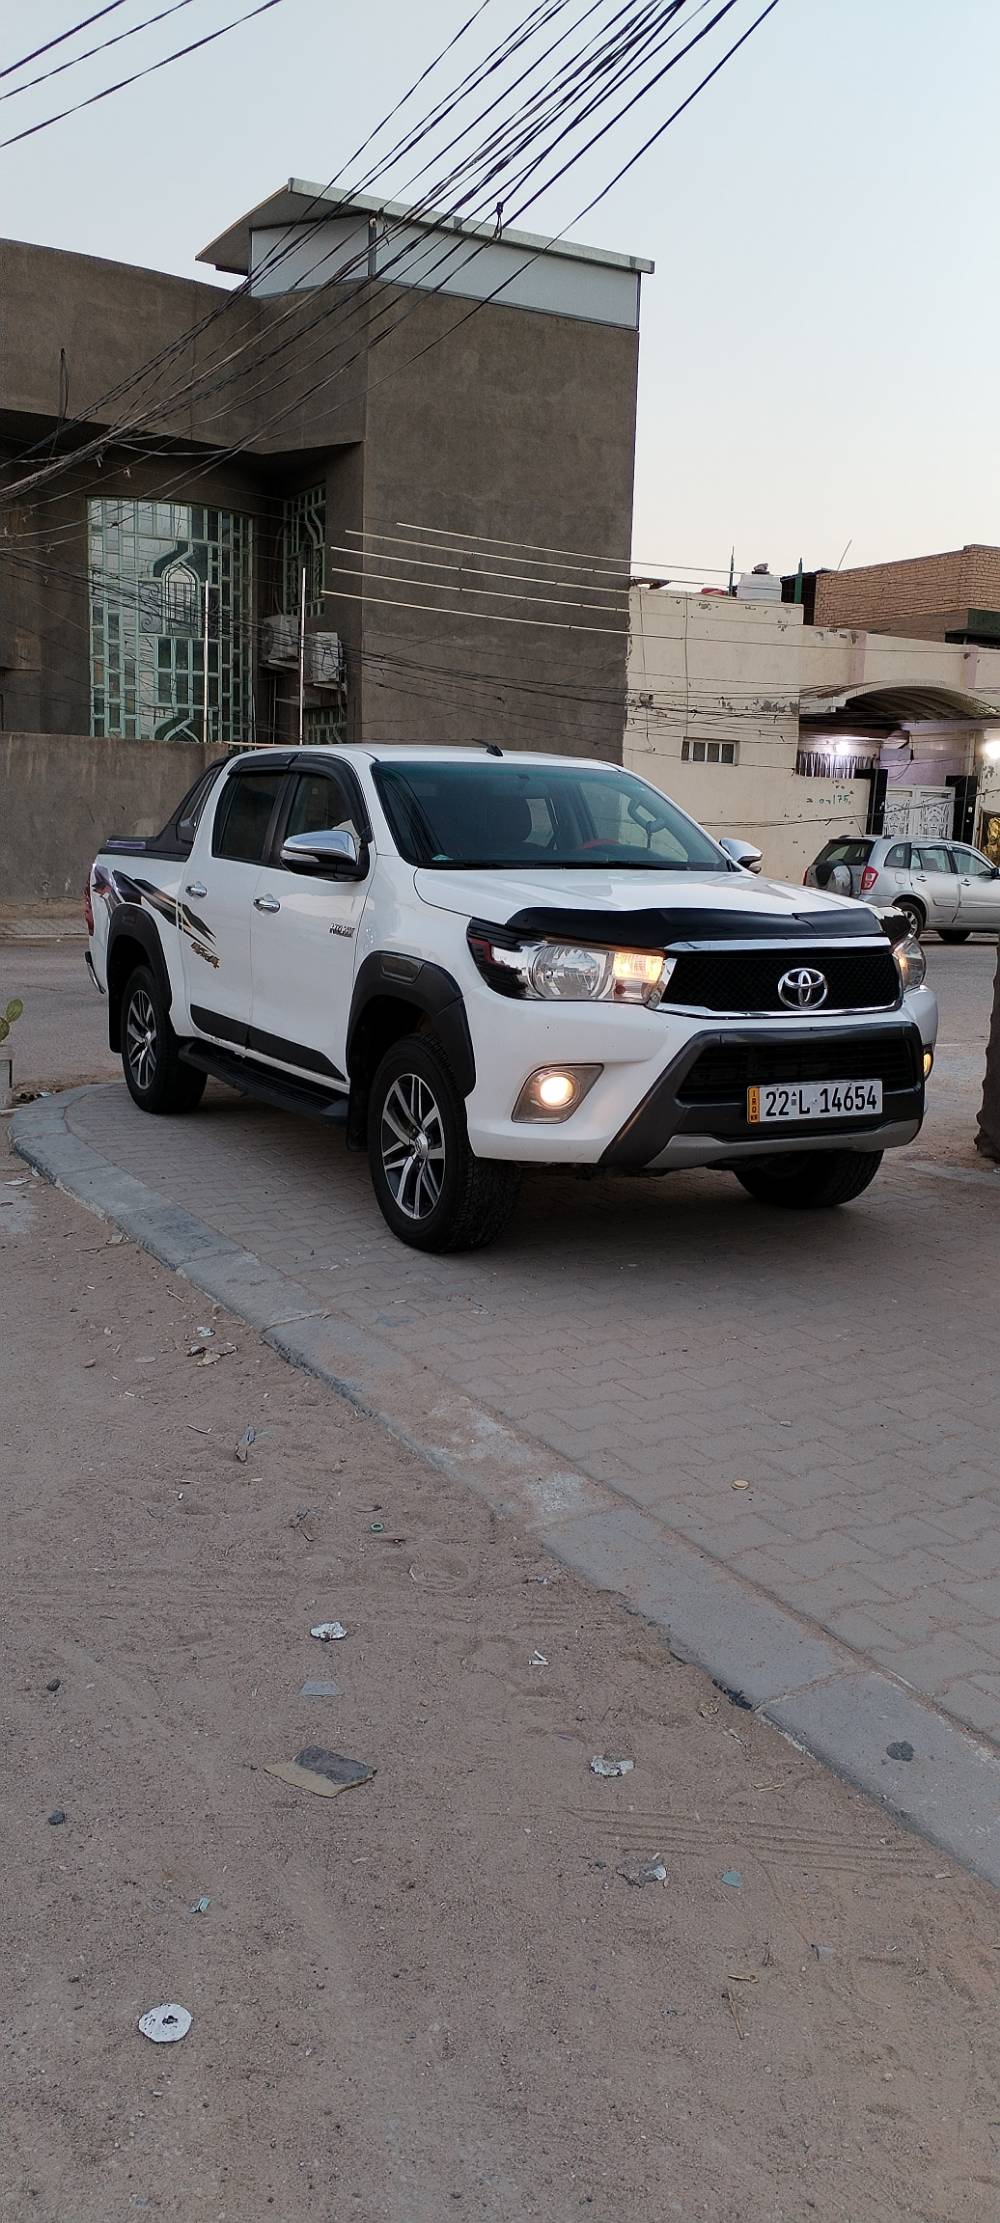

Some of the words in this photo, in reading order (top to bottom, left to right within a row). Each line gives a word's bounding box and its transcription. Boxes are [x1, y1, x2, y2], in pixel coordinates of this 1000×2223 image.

[766, 1090, 789, 1116] 22
[799, 1089, 810, 1115] L
[819, 1085, 877, 1113] 14654
